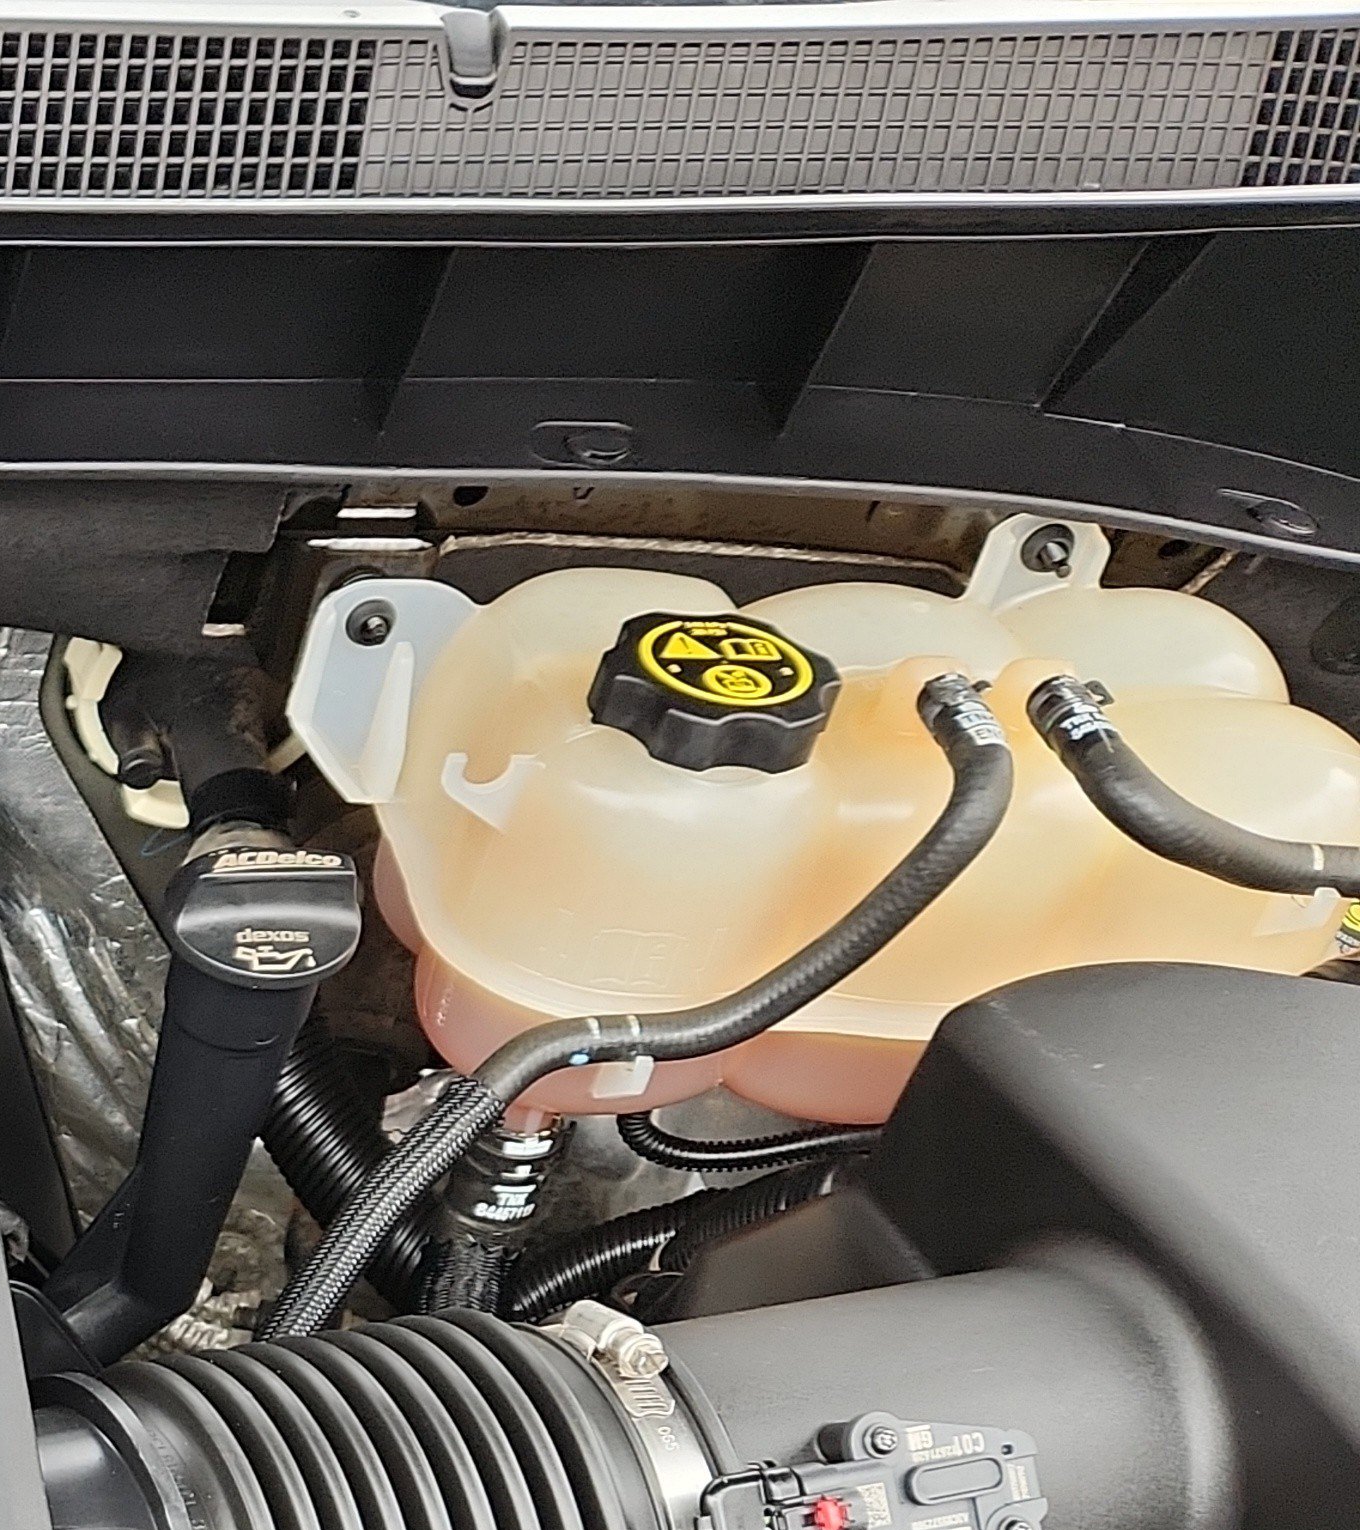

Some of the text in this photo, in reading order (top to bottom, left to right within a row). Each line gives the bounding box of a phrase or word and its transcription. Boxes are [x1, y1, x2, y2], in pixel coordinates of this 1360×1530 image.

[212, 850, 343, 868] ACDelco
[235, 928, 310, 943] dexos
[906, 1430, 934, 1452] GM
